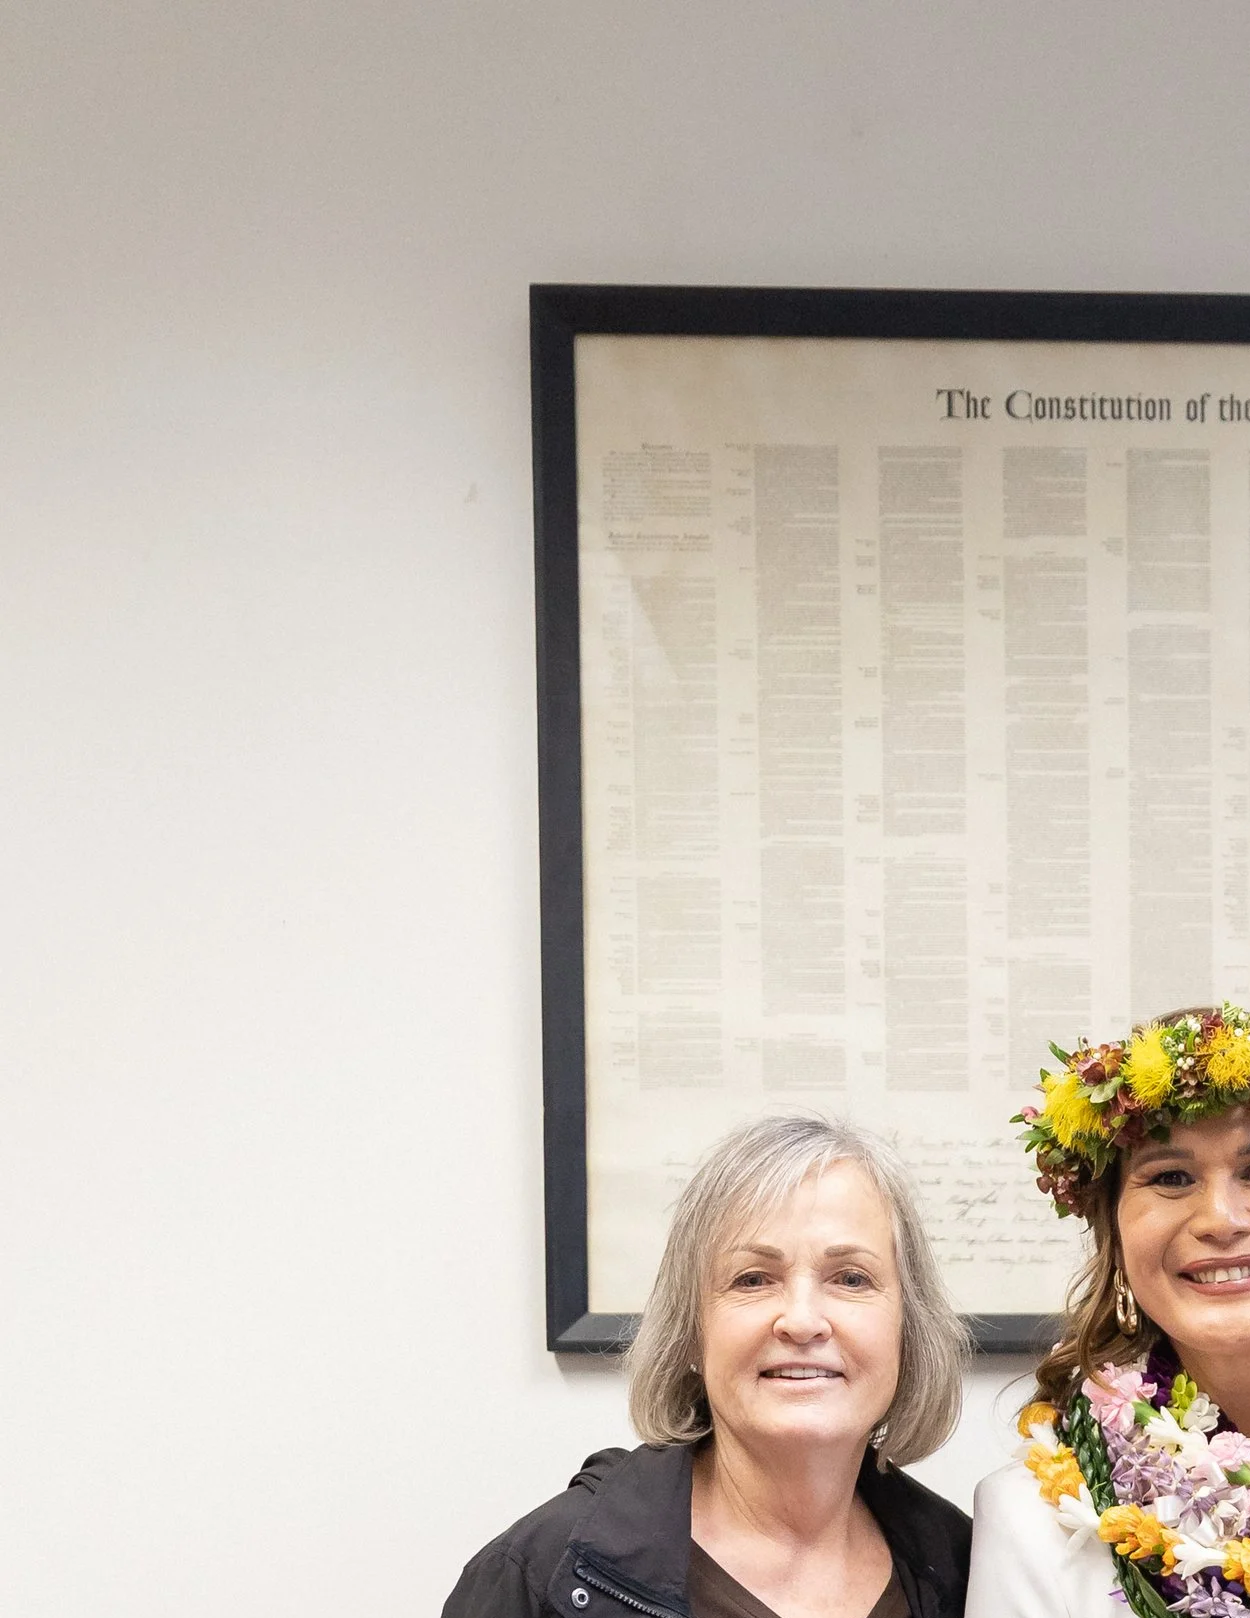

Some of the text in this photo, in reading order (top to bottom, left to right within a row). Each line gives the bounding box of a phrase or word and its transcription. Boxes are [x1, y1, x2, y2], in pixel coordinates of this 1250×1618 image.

[936, 388, 991, 421] The
[1004, 389, 1172, 424] Constitution
[1186, 392, 1211, 423] of
